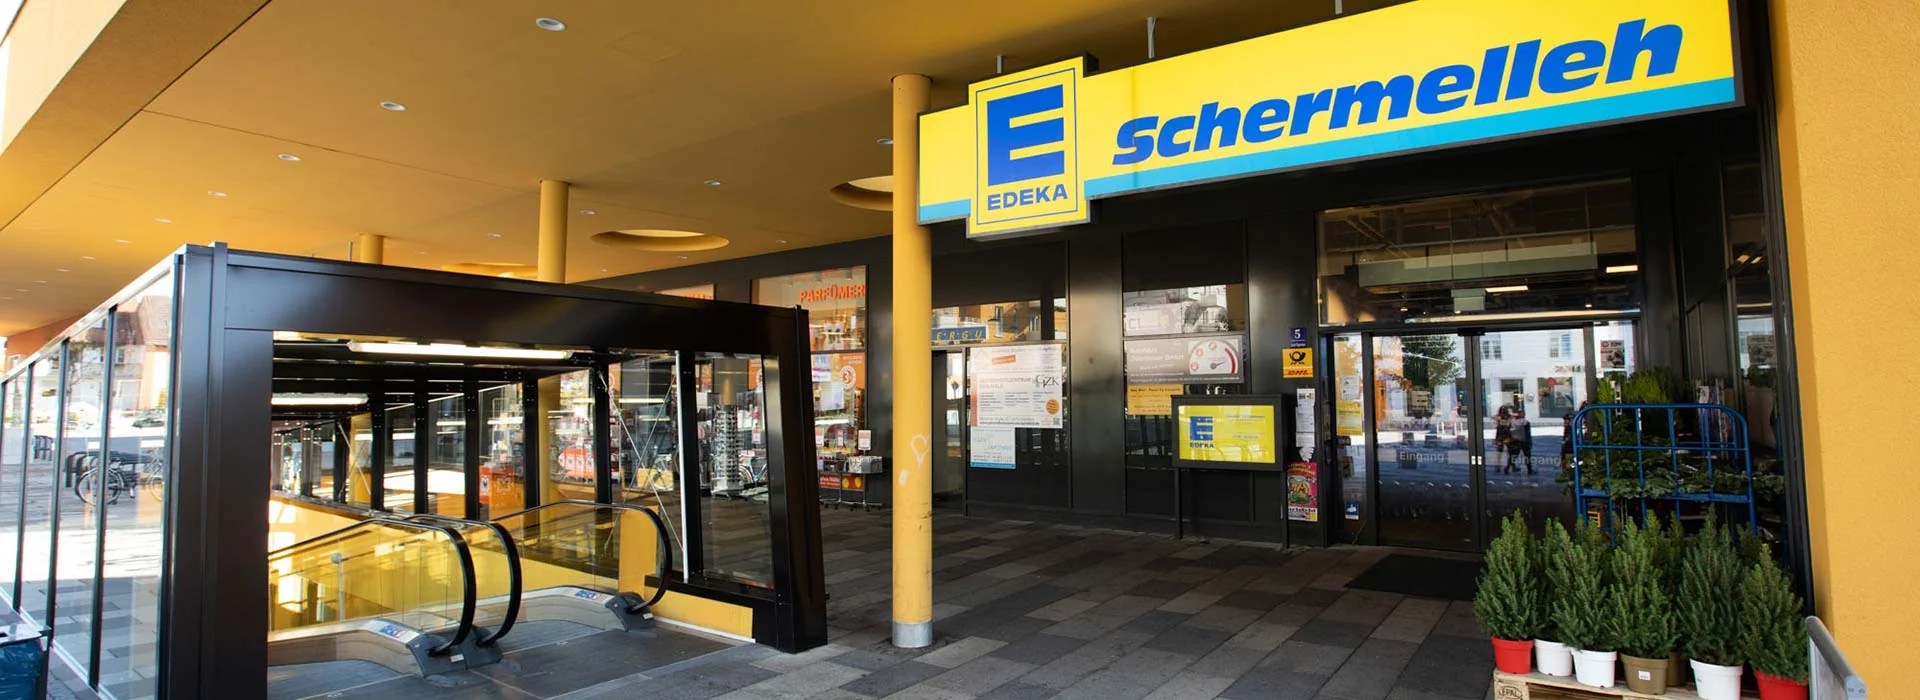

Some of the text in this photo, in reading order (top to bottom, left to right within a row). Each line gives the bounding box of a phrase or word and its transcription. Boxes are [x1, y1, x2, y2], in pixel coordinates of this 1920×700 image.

[1112, 18, 1684, 166] Schermelleh
[986, 84, 1065, 187] E
[987, 183, 1068, 211] EDEKA
[1294, 329, 1301, 340] 5
[1399, 451, 1445, 463] Eingang
